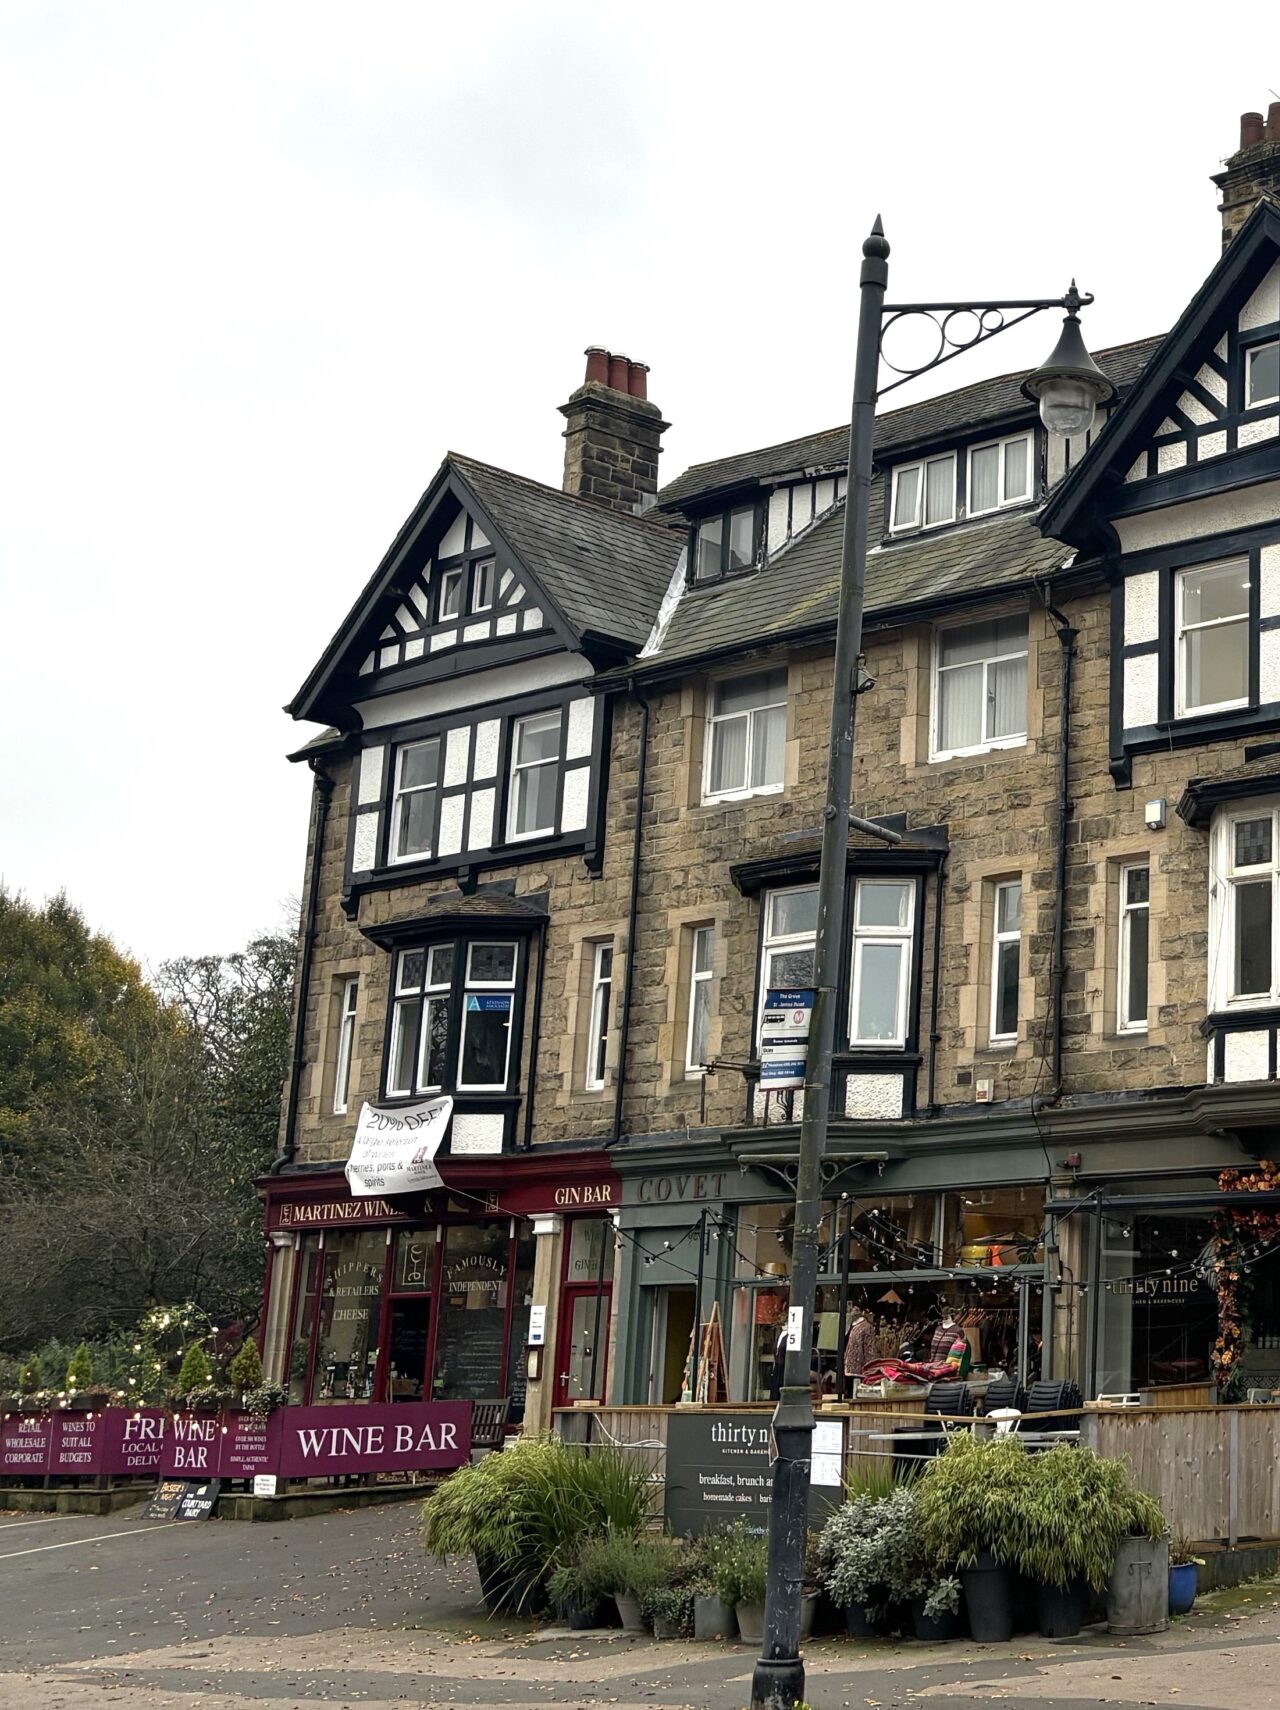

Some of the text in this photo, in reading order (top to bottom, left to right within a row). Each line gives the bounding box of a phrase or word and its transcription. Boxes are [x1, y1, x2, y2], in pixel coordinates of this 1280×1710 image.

[366, 1113, 403, 1131] 20%
[377, 1162, 396, 1173] ports
[364, 1177, 385, 1190] spirits
[637, 1173, 727, 1203] COVET
[554, 1185, 611, 1205] GIN BAR
[293, 1202, 361, 1222] MARTINEZ
[364, 1200, 407, 1218] WIN
[447, 1255, 507, 1280] FAMOUSLY
[336, 1285, 379, 1297] RETAILERS
[449, 1280, 503, 1293] INDEPENDENT
[1163, 1277, 1199, 1293] nine
[333, 1308, 369, 1321] CHEESE
[18, 1422, 42, 1433] RETAIL
[62, 1421, 96, 1432] WINES TO
[173, 1419, 216, 1441] WINE
[296, 1422, 458, 1458] WINE BAR
[711, 1422, 757, 1446] thirty
[5, 1437, 46, 1448] WHOLESALE
[61, 1436, 93, 1448] SUIT ALL
[121, 1442, 156, 1454] LOCAL
[5, 1452, 44, 1463] CORPORATE
[59, 1451, 92, 1463] BUDGETS
[127, 1455, 160, 1466] DELIV
[173, 1446, 208, 1468] BAR
[699, 1473, 735, 1486] breakfast,
[737, 1474, 764, 1486] brunch
[703, 1491, 735, 1502] homemade
[735, 1493, 753, 1503] cakes
[181, 1499, 212, 1509] COURTYARD
[184, 1508, 202, 1517] DAIRY
